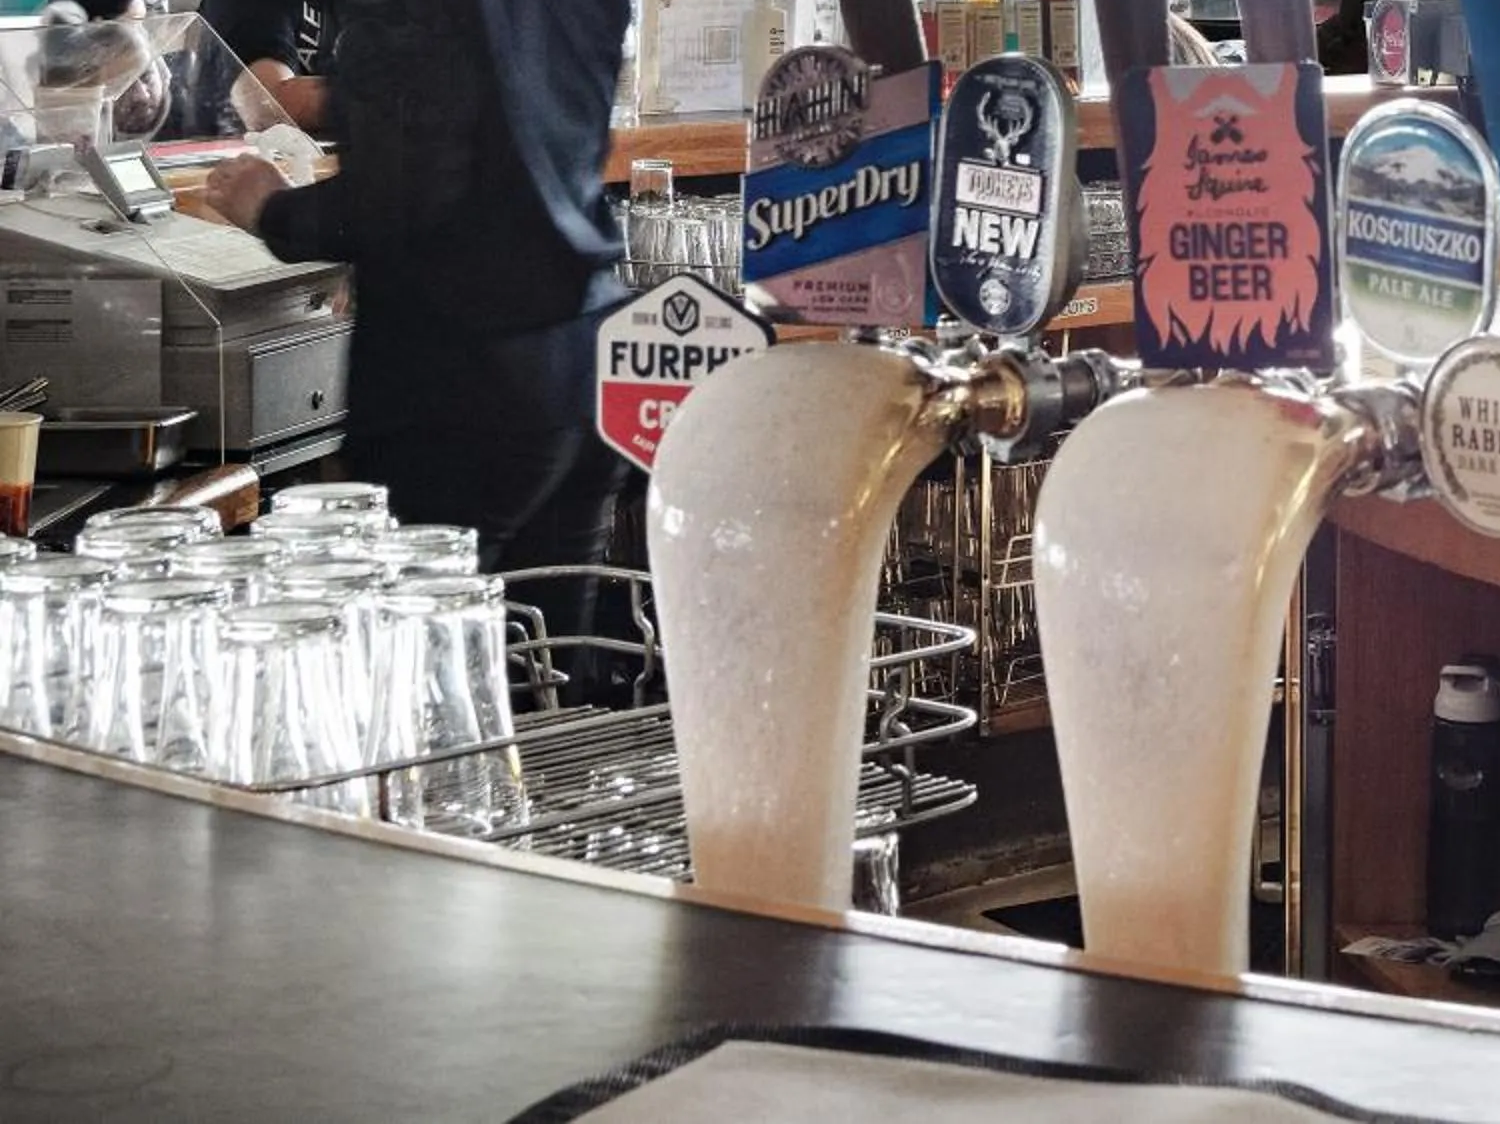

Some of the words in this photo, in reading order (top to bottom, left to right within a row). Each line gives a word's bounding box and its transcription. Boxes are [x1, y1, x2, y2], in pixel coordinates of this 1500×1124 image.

[754, 71, 869, 140] HAHN
[747, 162, 920, 251] SuperDry
[953, 208, 1039, 260] NEW
[1170, 222, 1288, 261] GINGER
[1348, 209, 1481, 264] KOSCIUSZKO
[794, 280, 869, 293] PREMIUM
[1189, 264, 1273, 302] BEER
[1367, 273, 1413, 301] PALE
[1418, 284, 1455, 309] ALE
[611, 341, 755, 380] FURPH
